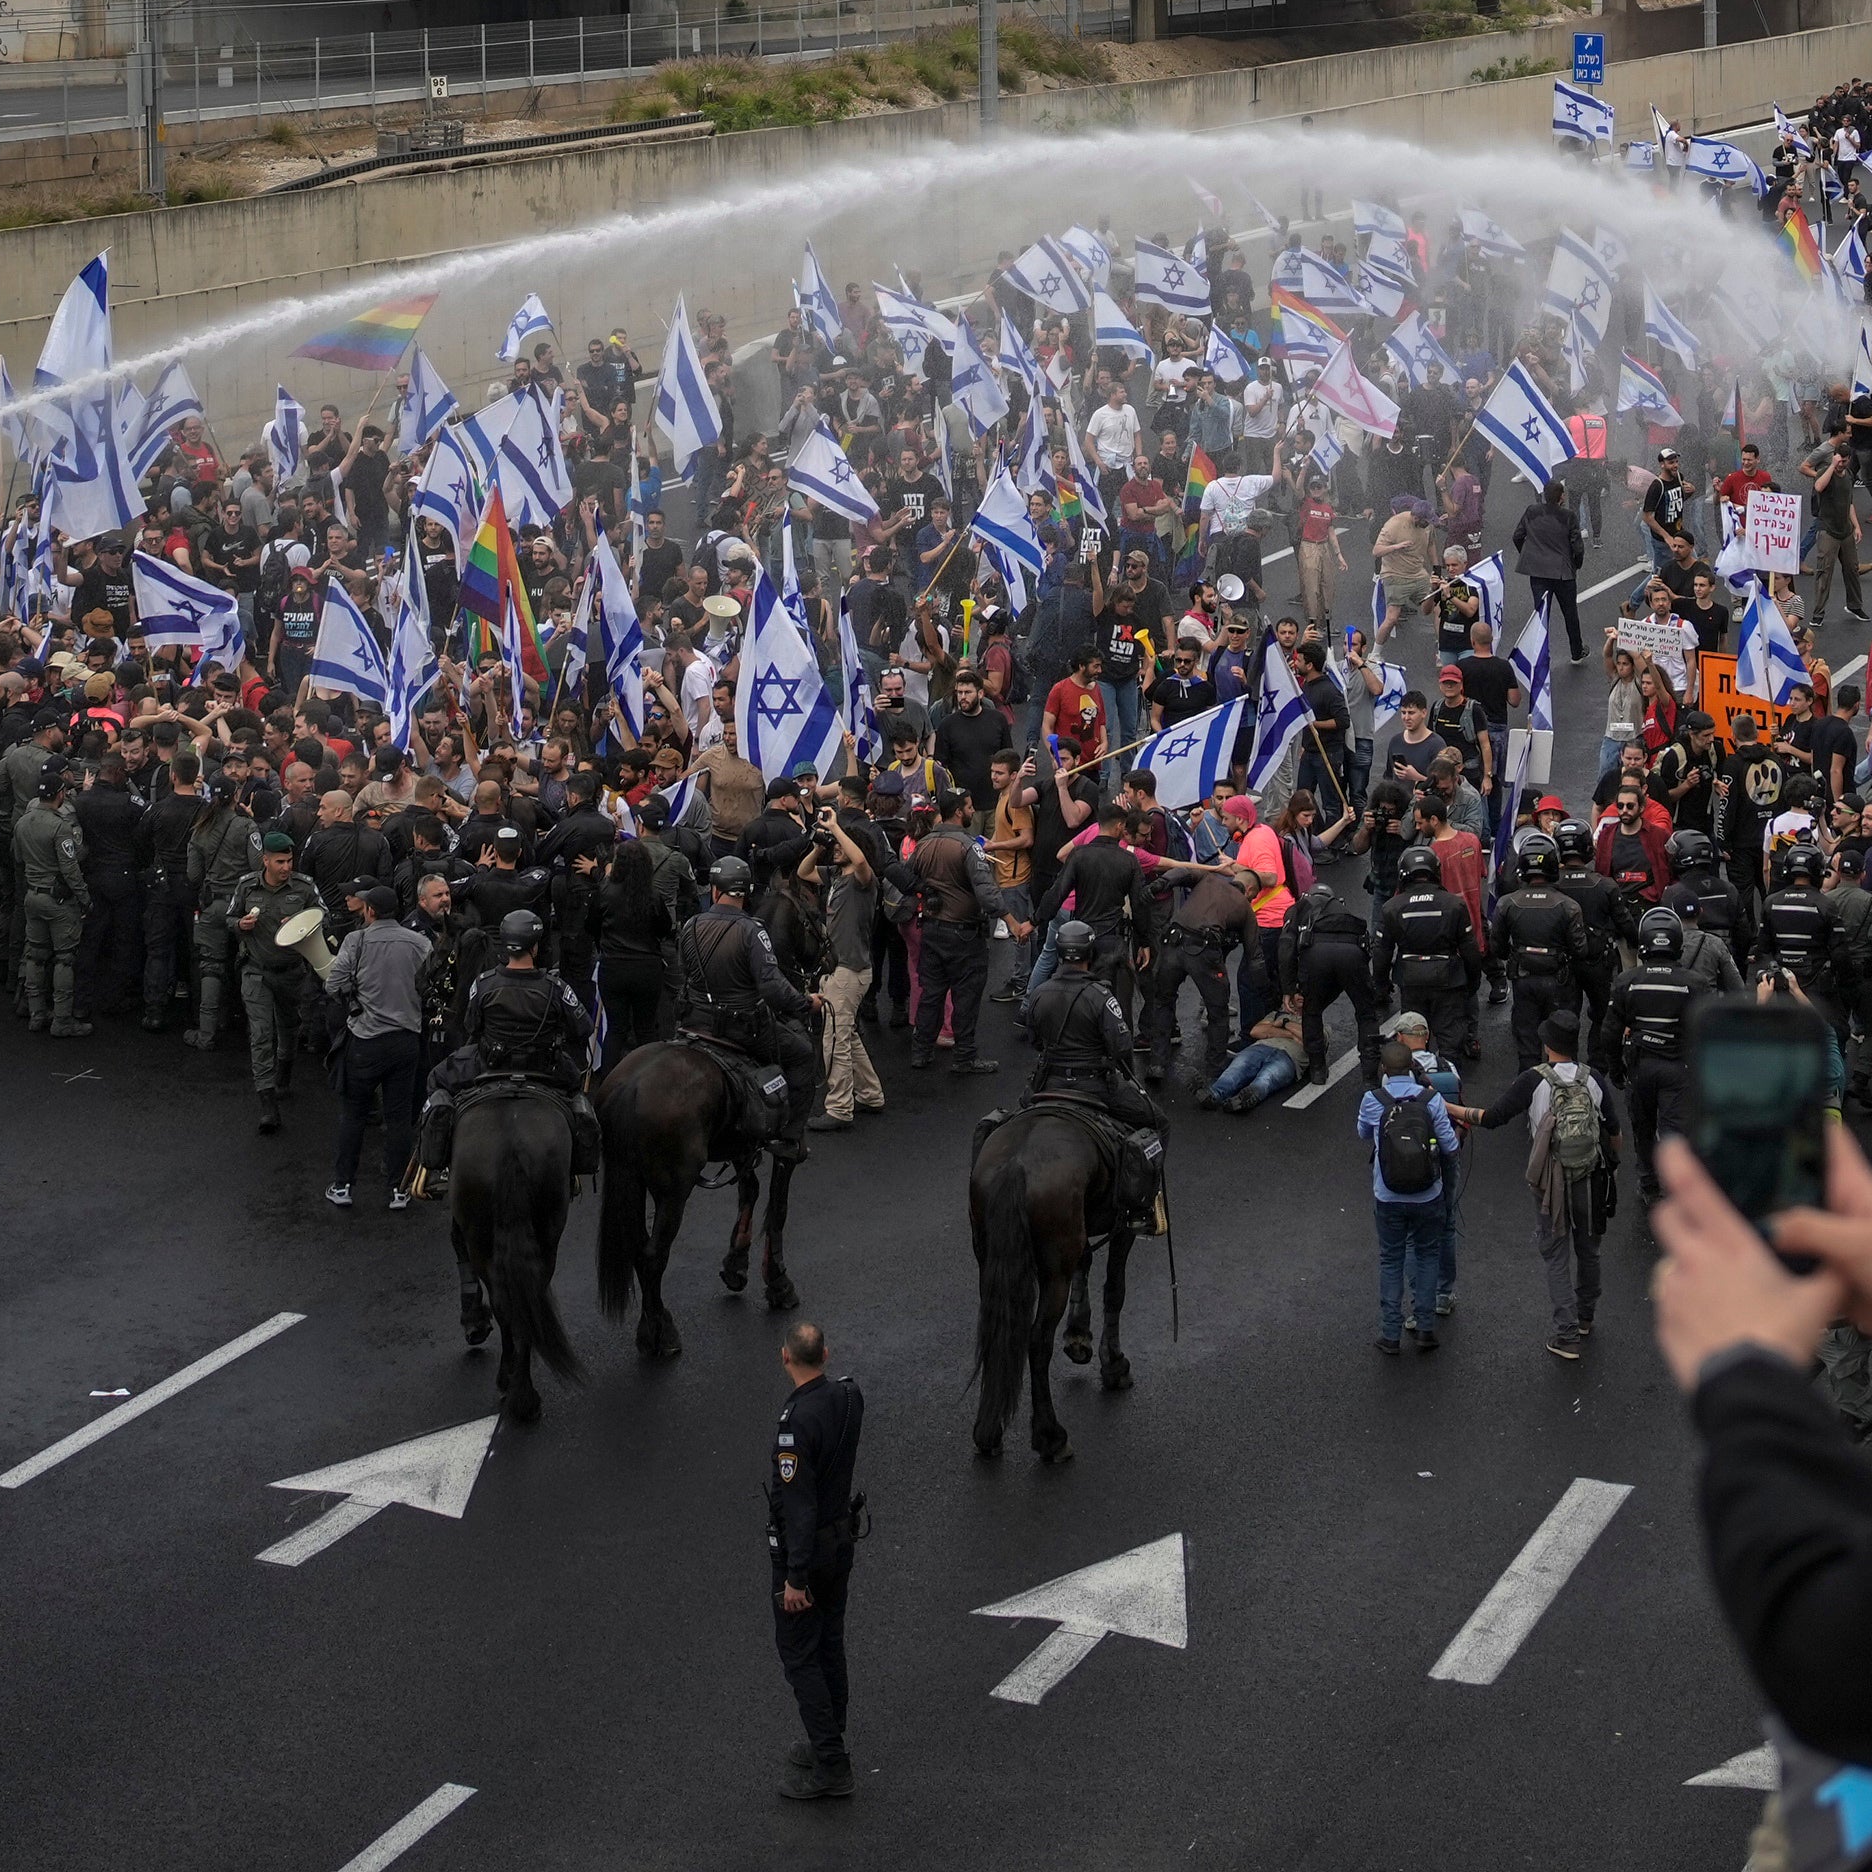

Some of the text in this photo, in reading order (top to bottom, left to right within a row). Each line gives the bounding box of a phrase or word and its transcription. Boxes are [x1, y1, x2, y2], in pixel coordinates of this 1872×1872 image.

[1578, 54, 1599, 65] לשלום
[1576, 68, 1601, 79] צא כאן
[1784, 495, 1796, 505] בן
[283, 612, 314, 622] נאמנים
